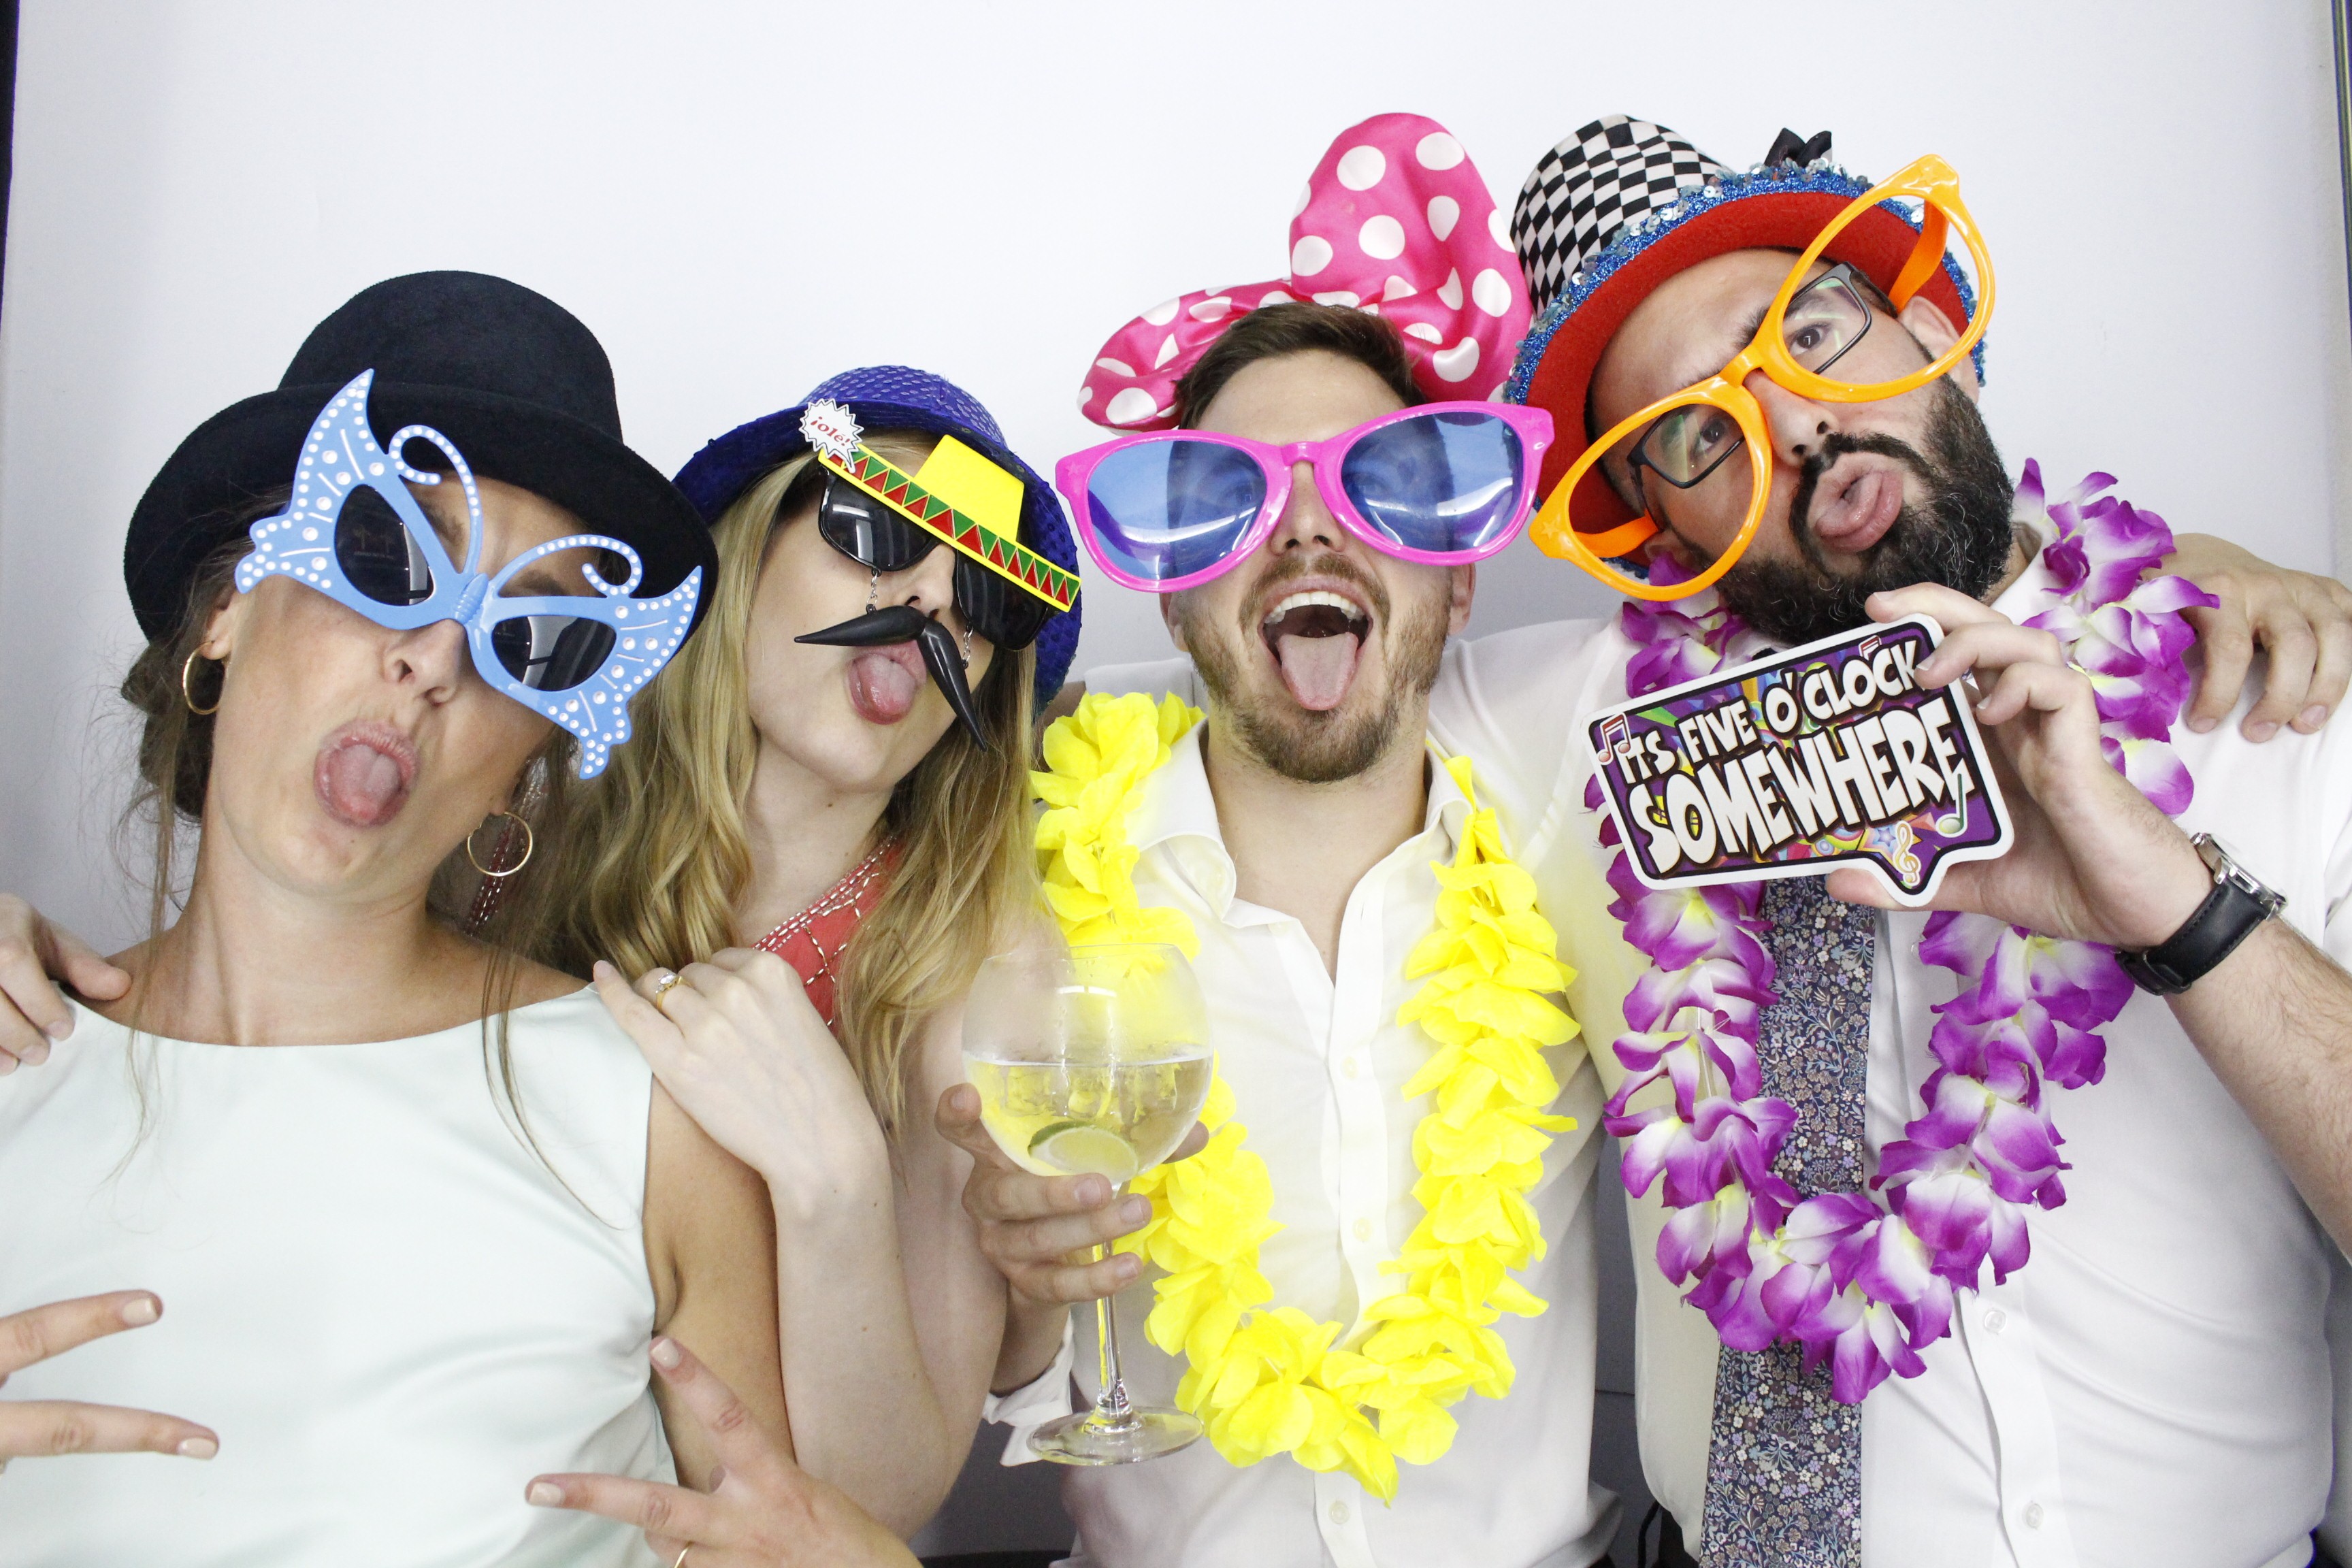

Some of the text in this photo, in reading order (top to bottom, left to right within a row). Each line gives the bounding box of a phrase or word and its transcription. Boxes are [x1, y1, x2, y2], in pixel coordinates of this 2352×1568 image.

[1678, 699, 1758, 764] FIVE
[1765, 640, 1926, 734] O'CLOCK
[1629, 696, 1976, 874] SOMEWHERE
